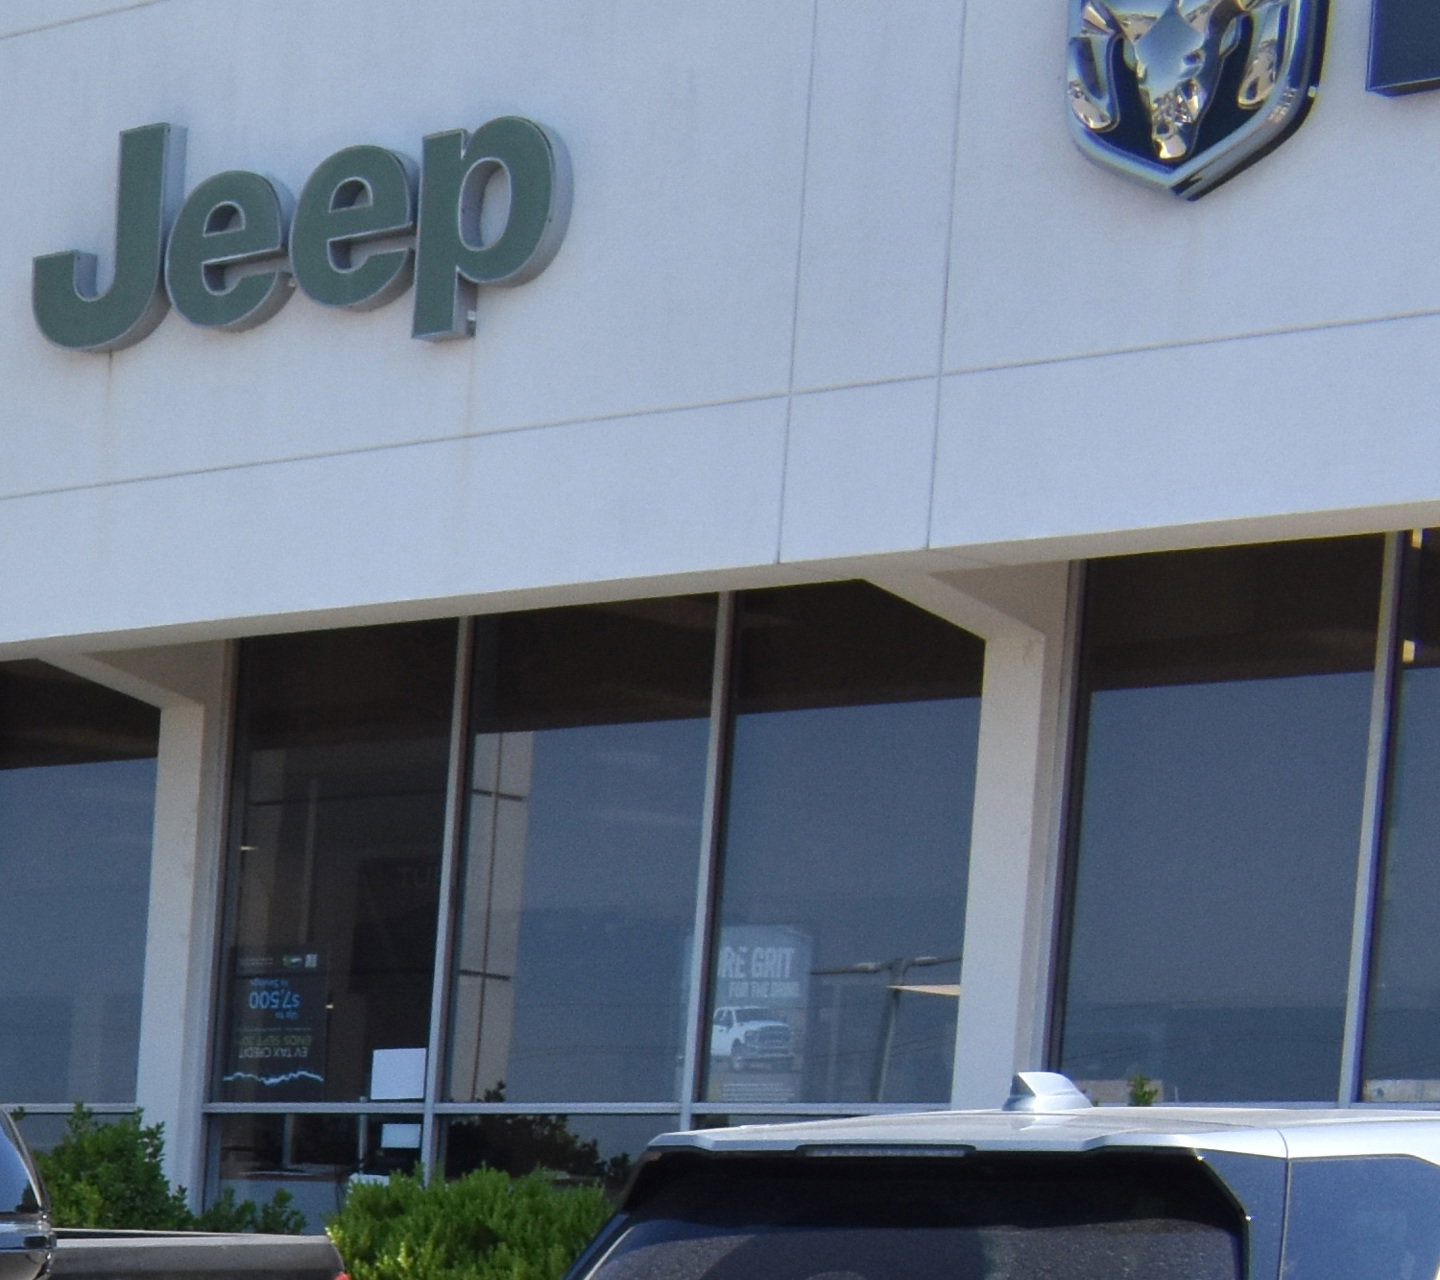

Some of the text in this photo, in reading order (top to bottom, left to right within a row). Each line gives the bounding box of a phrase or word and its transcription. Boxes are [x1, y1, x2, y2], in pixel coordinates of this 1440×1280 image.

[32, 115, 573, 353] Jeep
[751, 946, 796, 978] GRIT
[248, 988, 301, 1009] $7,500
